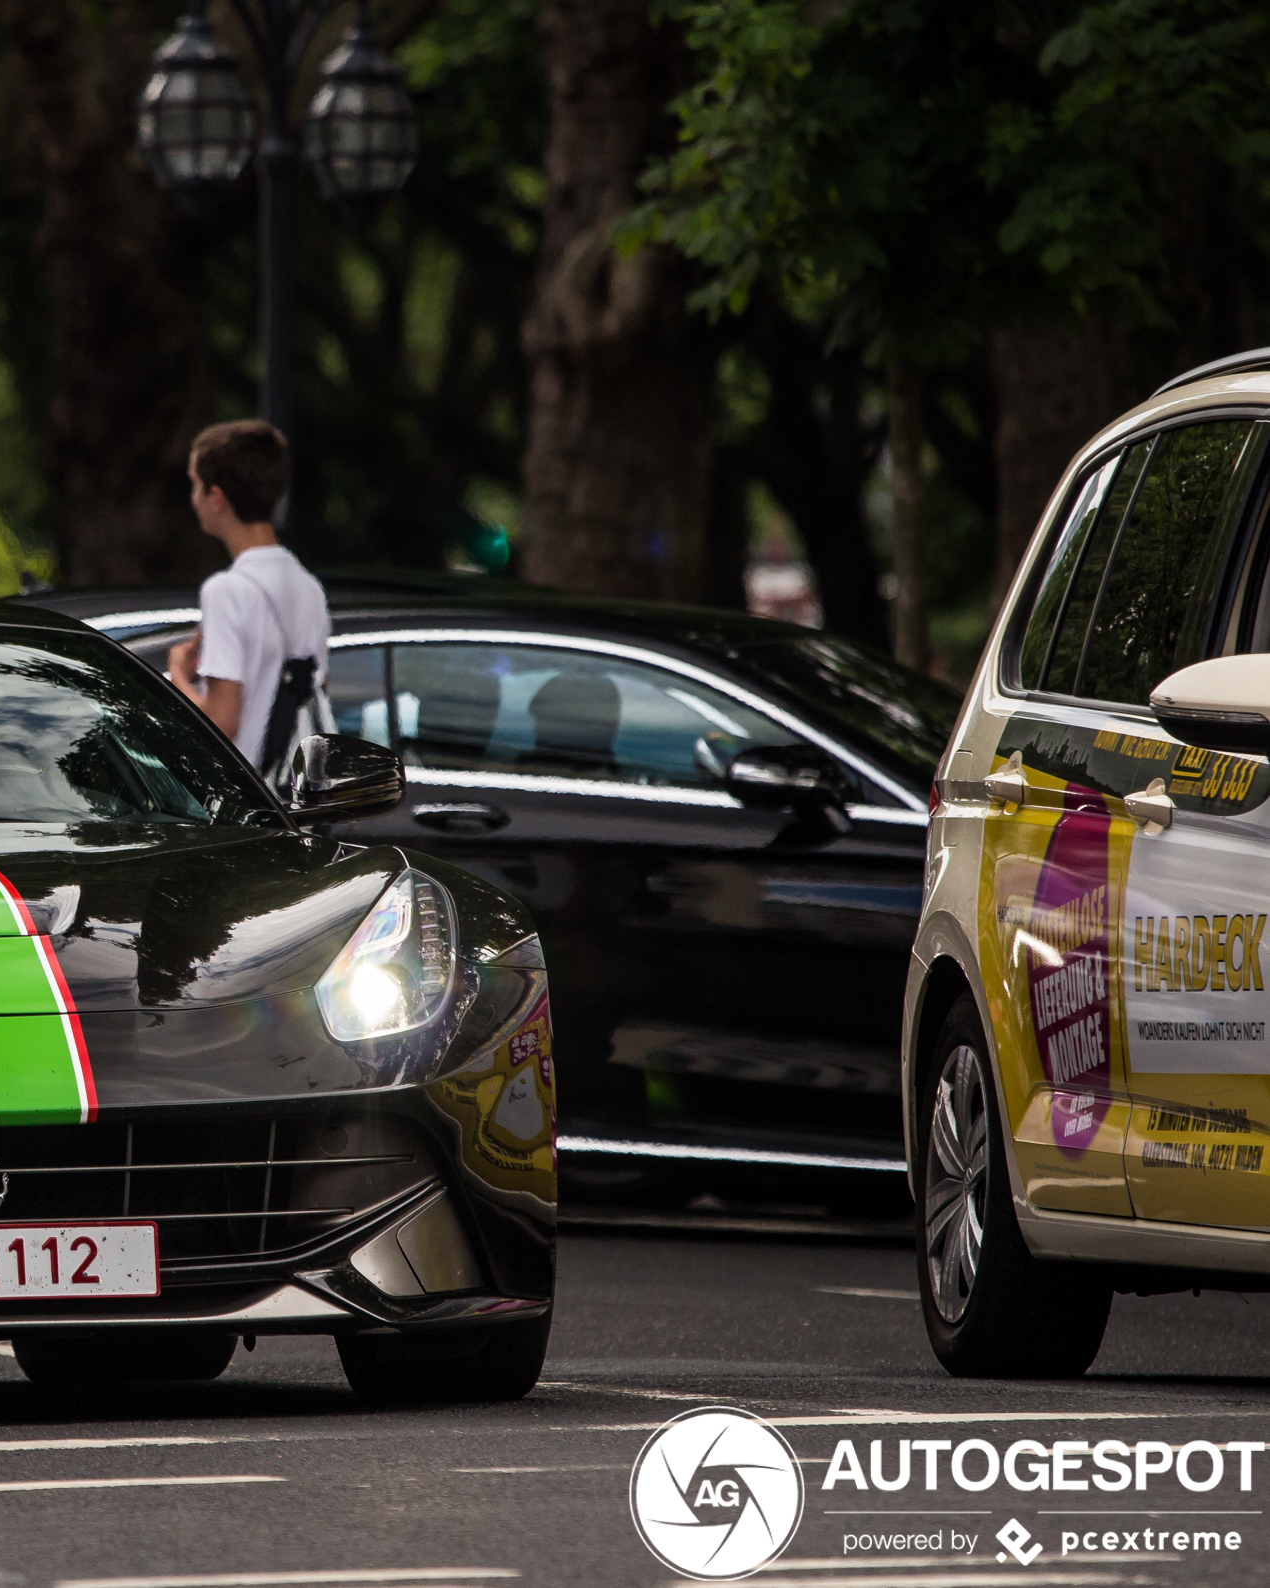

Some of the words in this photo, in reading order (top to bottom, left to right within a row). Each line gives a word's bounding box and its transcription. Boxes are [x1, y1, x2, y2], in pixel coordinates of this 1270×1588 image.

[1180, 746, 1207, 768] TAXI
[1202, 754, 1231, 798] 33
[1222, 758, 1259, 801] 333
[1134, 914, 1267, 992] HARDECK
[1034, 955, 1094, 1030] LIEFERUNG
[1094, 950, 1106, 1001] &
[1047, 1011, 1106, 1086] MONTAGE
[1137, 1021, 1174, 1041] WOANDERS
[1174, 1021, 1200, 1041] KAUFEN
[1201, 1021, 1224, 1041] LOHNT
[1225, 1021, 1242, 1041] SICH
[1243, 1021, 1265, 1041] NICHT
[1208, 1144, 1235, 1170] 40721
